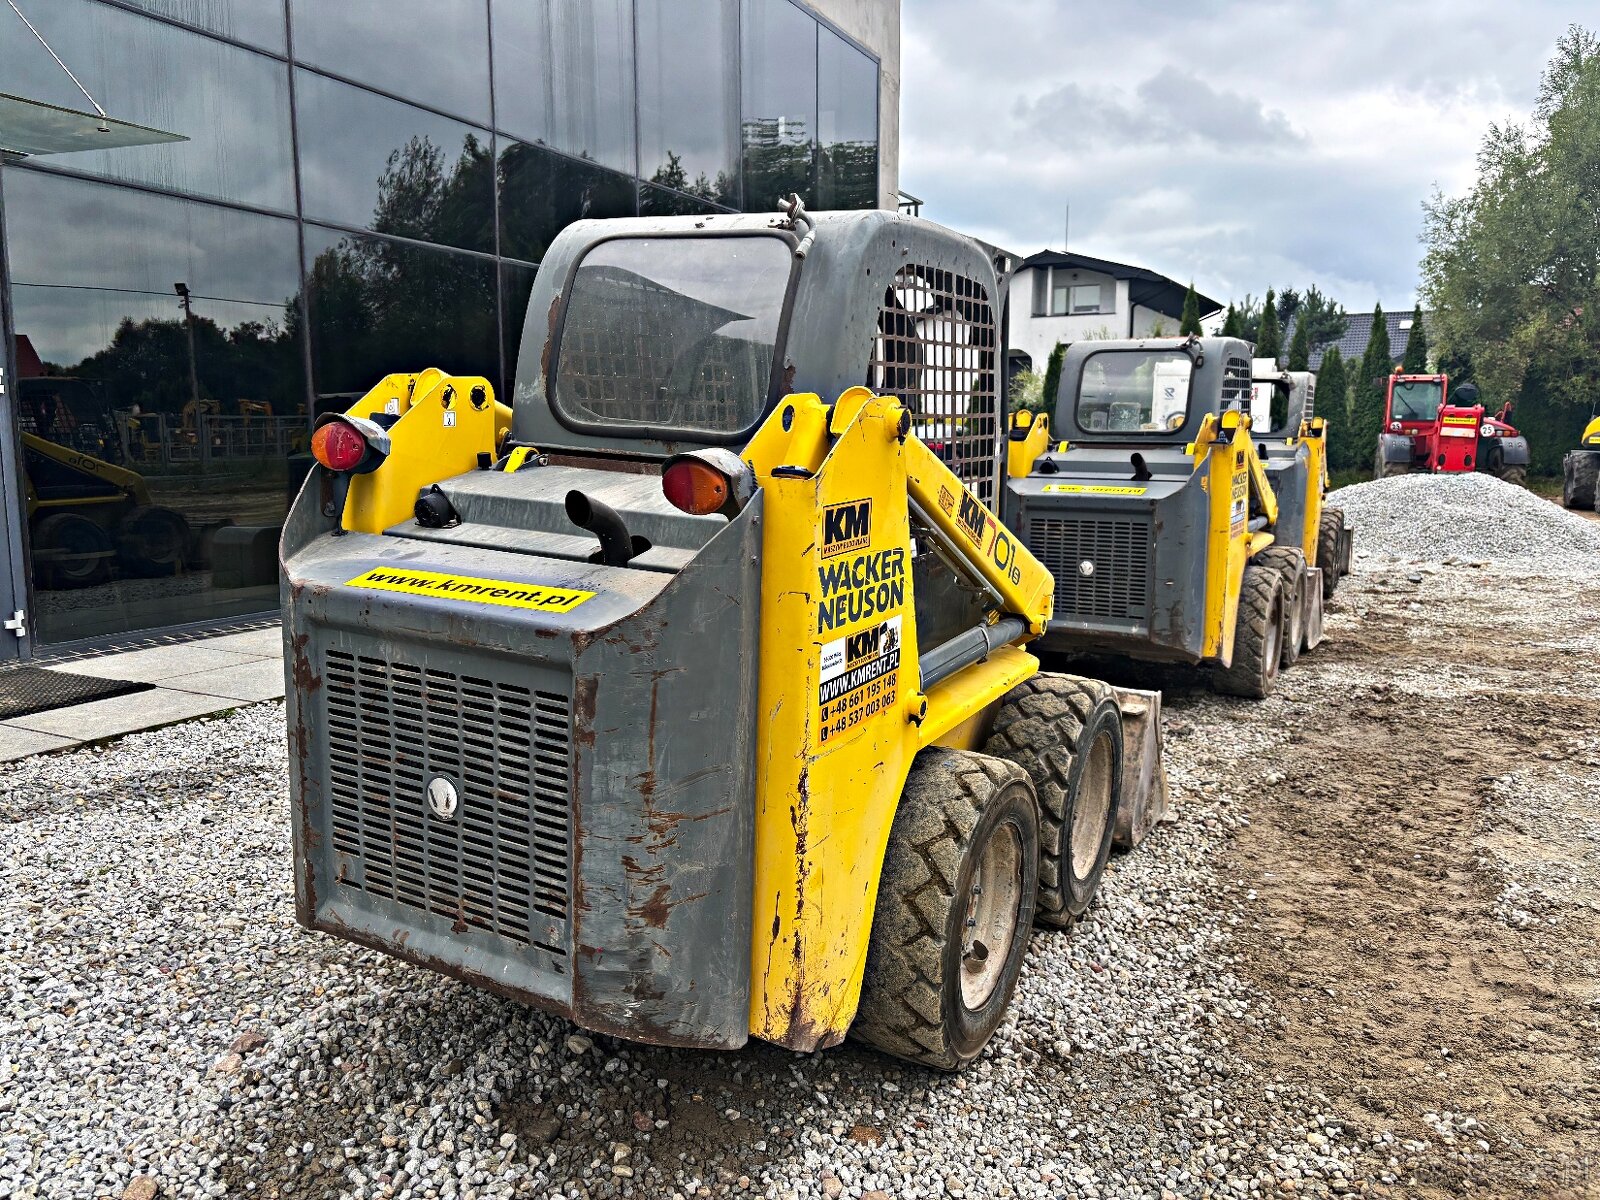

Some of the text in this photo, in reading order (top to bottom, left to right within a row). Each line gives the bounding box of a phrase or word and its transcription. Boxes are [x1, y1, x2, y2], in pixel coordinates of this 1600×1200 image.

[1482, 426, 1492, 435] 25
[824, 502, 870, 546] KM
[958, 489, 986, 540] KM
[366, 572, 581, 607] www.kmrent.pl
[818, 547, 905, 599] WACKER
[818, 576, 905, 635] NEUSON
[847, 626, 879, 663] KM
[819, 651, 899, 703] WWW.KMRENT.PL
[830, 672, 896, 717] +48 661 195 148
[830, 689, 896, 736] +48 537 003 063
